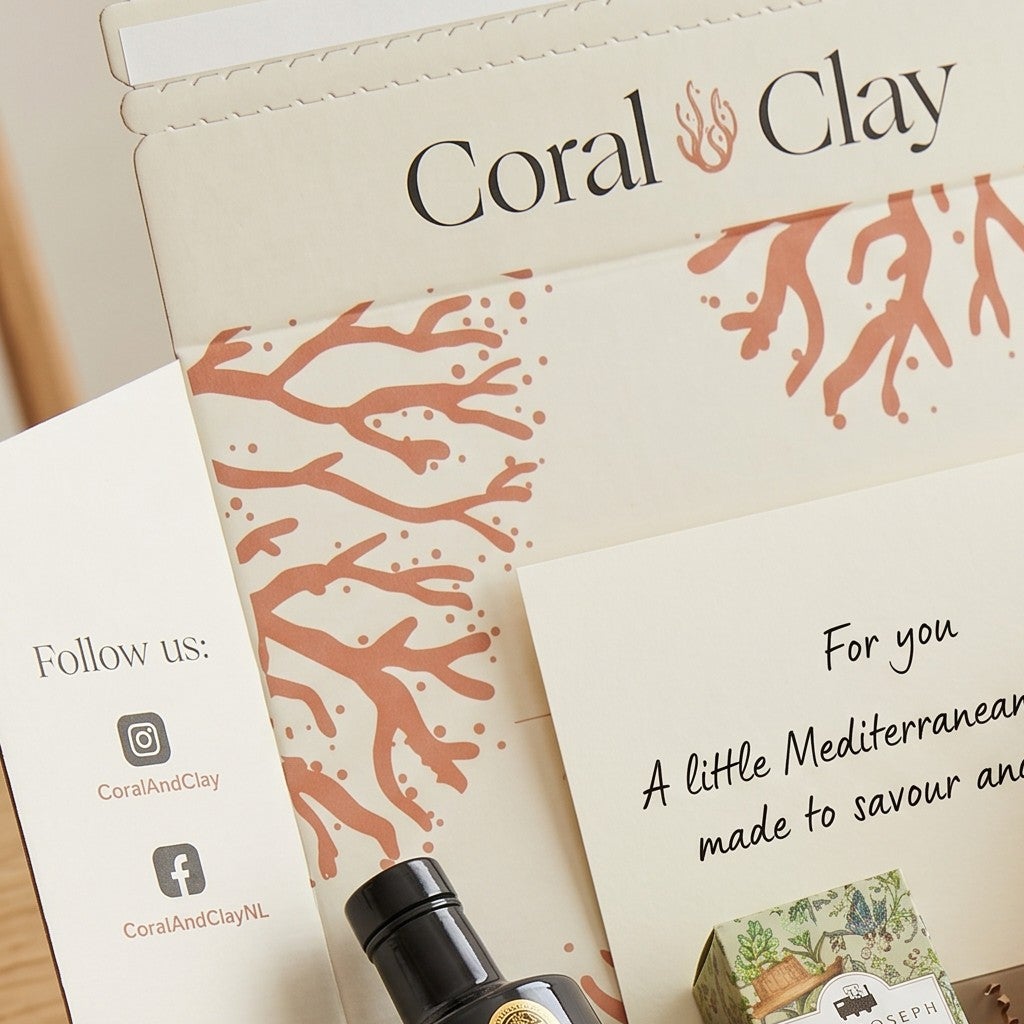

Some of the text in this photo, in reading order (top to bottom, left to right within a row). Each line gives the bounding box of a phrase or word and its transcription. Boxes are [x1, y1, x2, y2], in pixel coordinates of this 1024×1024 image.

[406, 49, 957, 227] Coral Clay
[32, 635, 210, 678] Follow us:
[822, 617, 959, 674] For you
[97, 771, 220, 801] CoralAndClay
[642, 759, 671, 810] A
[685, 741, 772, 794] little
[698, 803, 792, 862] made
[804, 794, 836, 833] to
[853, 773, 961, 823] savour
[123, 902, 270, 939] CoralAndClayNL
